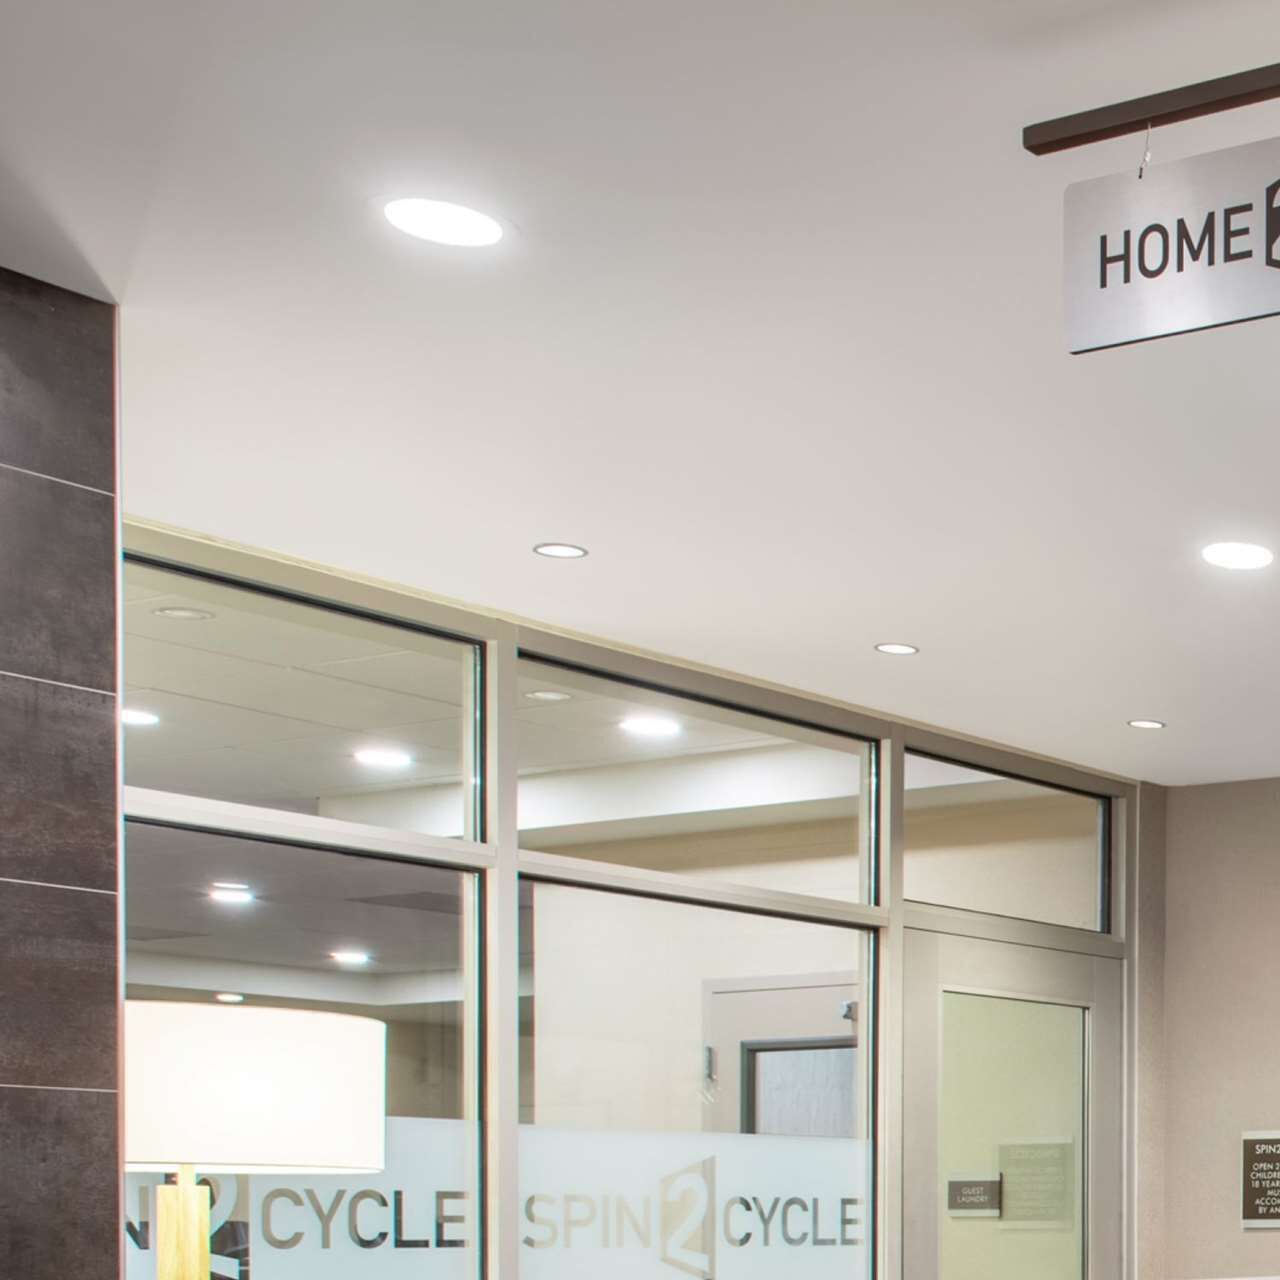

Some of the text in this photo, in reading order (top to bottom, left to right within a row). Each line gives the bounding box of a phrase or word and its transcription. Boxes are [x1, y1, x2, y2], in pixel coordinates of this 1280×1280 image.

[1252, 1162, 1274, 1171] OPEN
[1258, 1206, 1267, 1214] BY
[1269, 1206, 1280, 1214] AN
